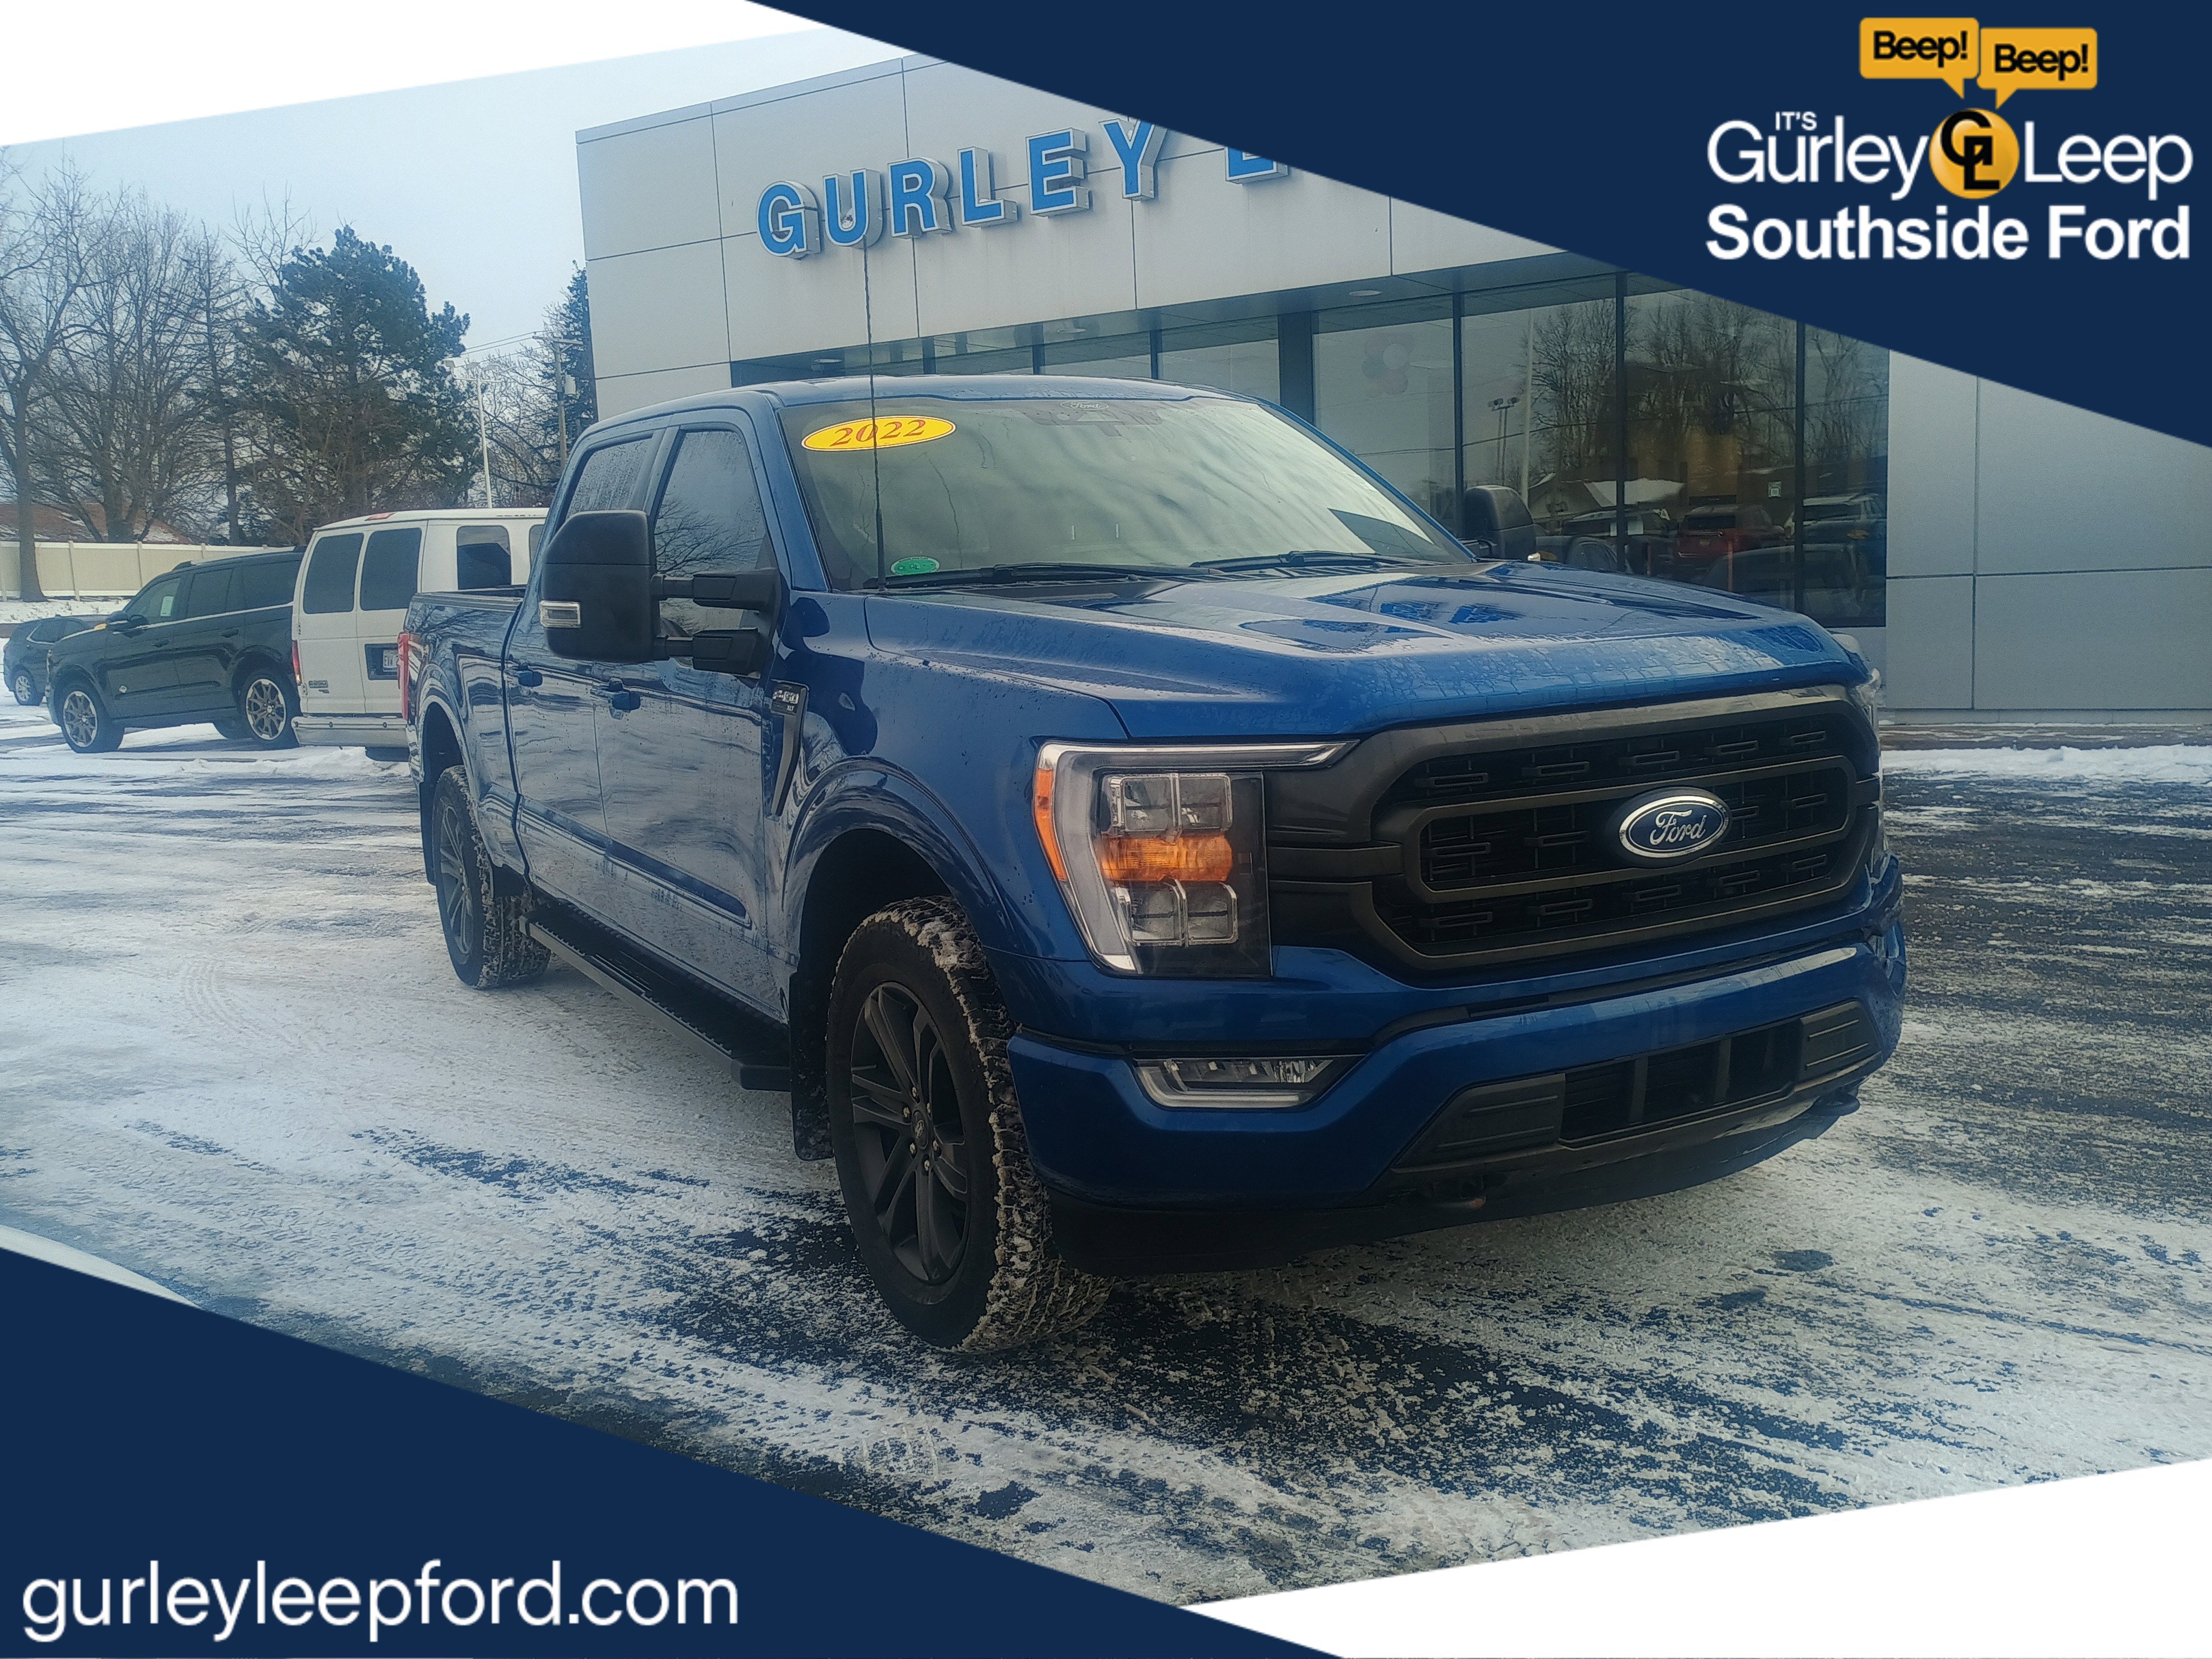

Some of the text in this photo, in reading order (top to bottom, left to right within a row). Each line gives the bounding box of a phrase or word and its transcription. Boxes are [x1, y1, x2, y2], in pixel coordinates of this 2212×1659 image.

[757, 117, 1169, 260] GURLEY
[829, 420, 926, 447] 2022
[1650, 810, 1707, 845] Ford
